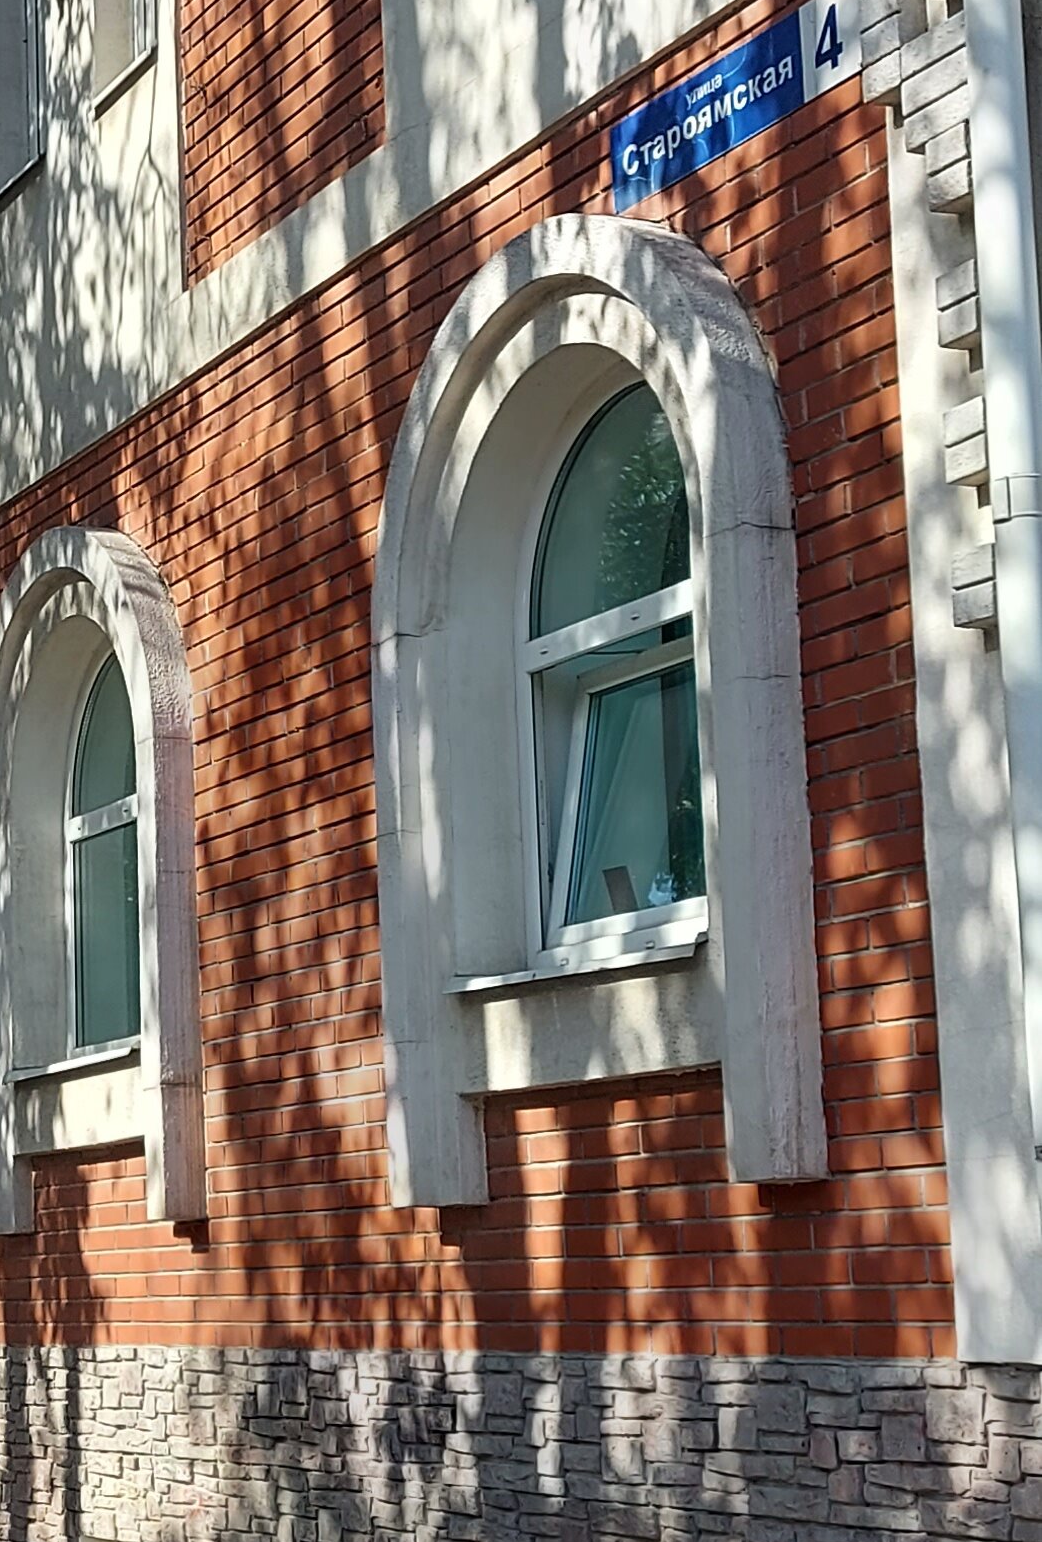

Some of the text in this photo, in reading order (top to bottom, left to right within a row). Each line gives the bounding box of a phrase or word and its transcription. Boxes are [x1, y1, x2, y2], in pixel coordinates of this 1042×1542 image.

[814, 3, 844, 70] 4
[622, 56, 794, 176] Староямская
[686, 73, 723, 110] улица
